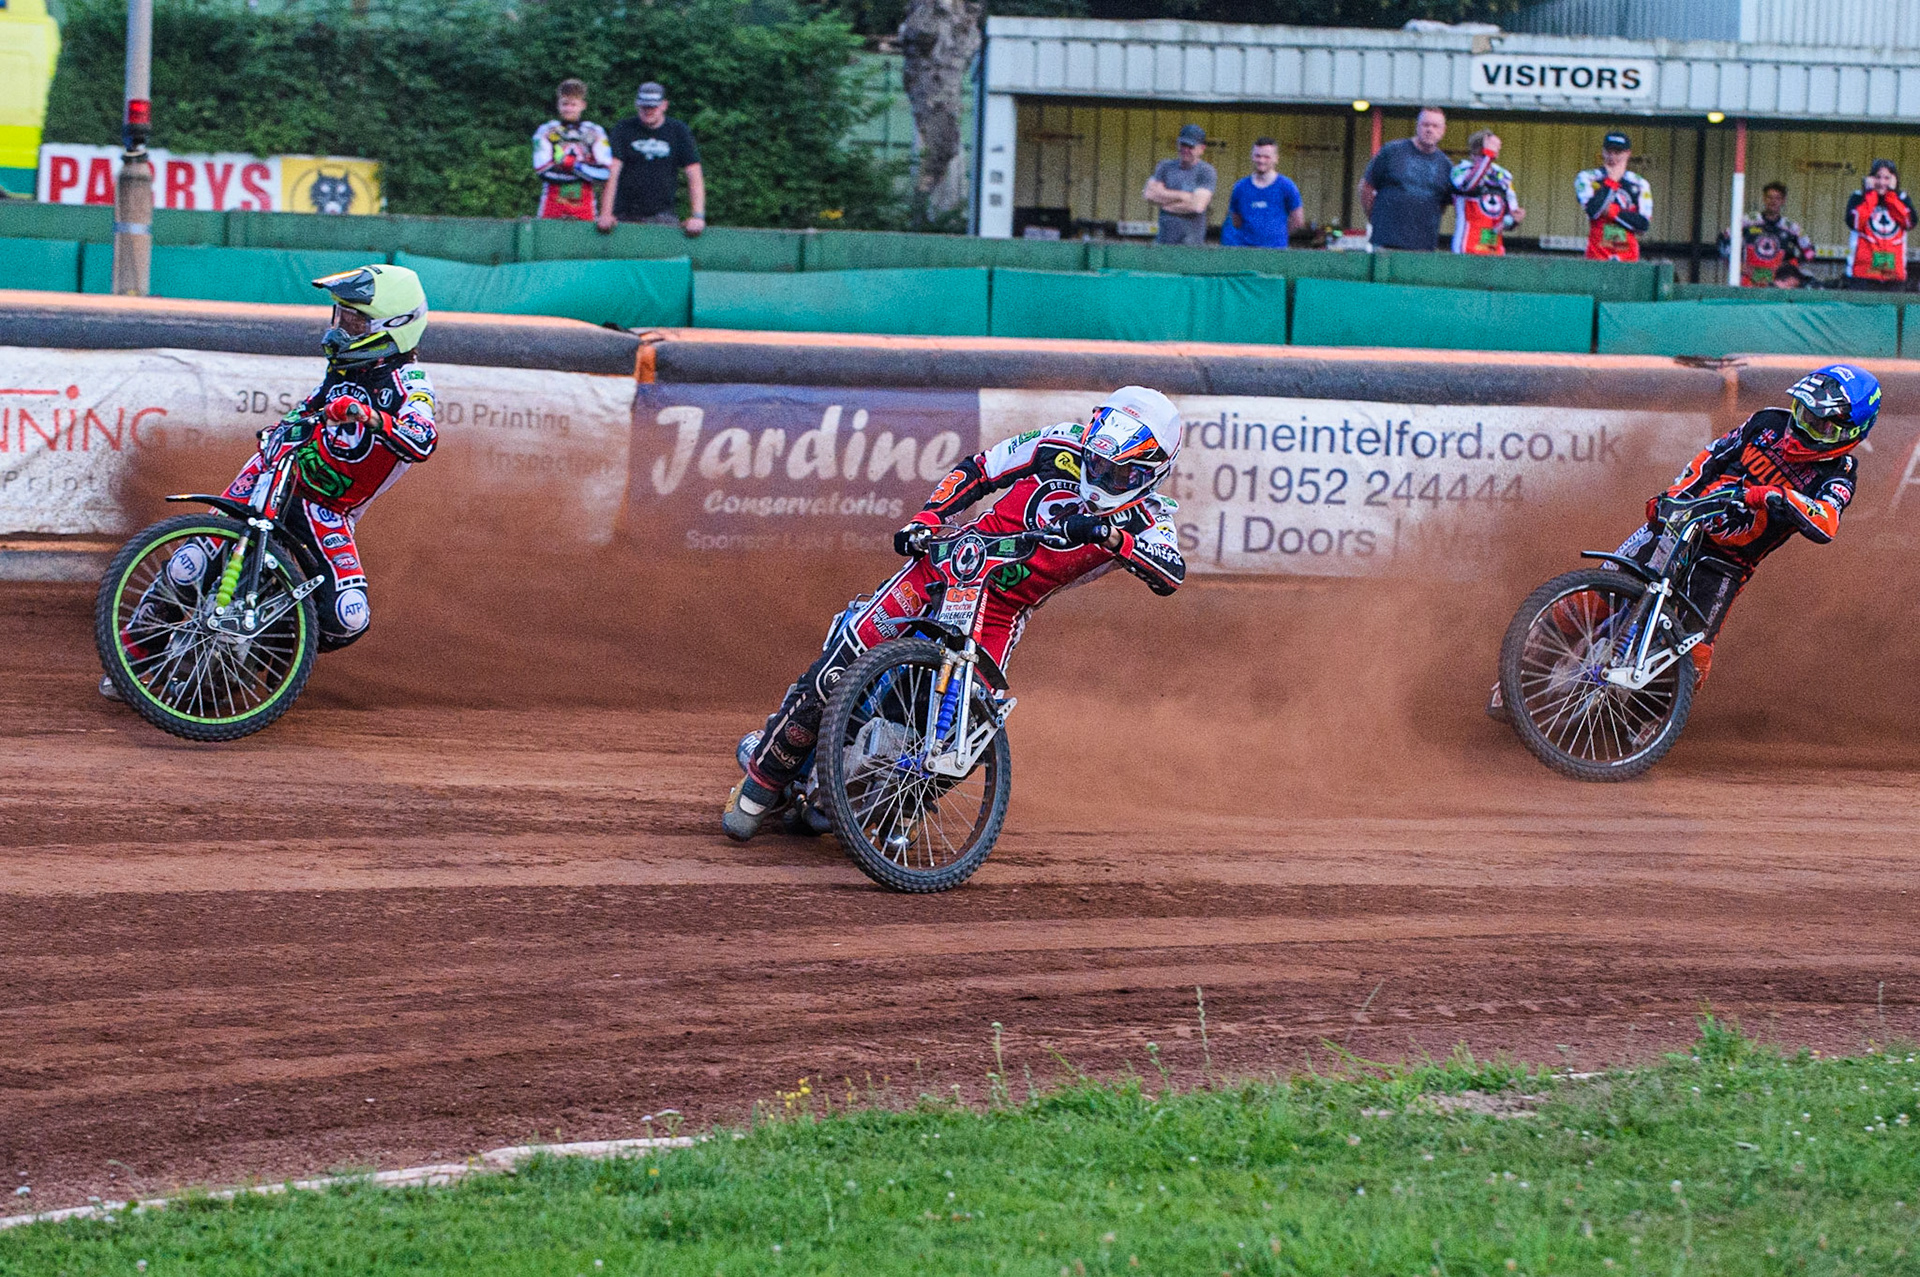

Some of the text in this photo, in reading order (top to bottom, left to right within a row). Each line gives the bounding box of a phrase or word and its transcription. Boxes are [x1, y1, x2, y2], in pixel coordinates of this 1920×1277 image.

[1482, 64, 1641, 90] VISITORS
[50, 156, 272, 212] PARYS
[236, 390, 269, 414] 3D
[473, 403, 571, 437] Printing
[651, 405, 961, 494] Jardine
[1184, 412, 1620, 463] rdineintelford.co.uk
[703, 490, 904, 518] Conservatories
[1212, 463, 1348, 506] 01952
[1364, 471, 1524, 511] 244444
[1242, 516, 1375, 558] Doors
